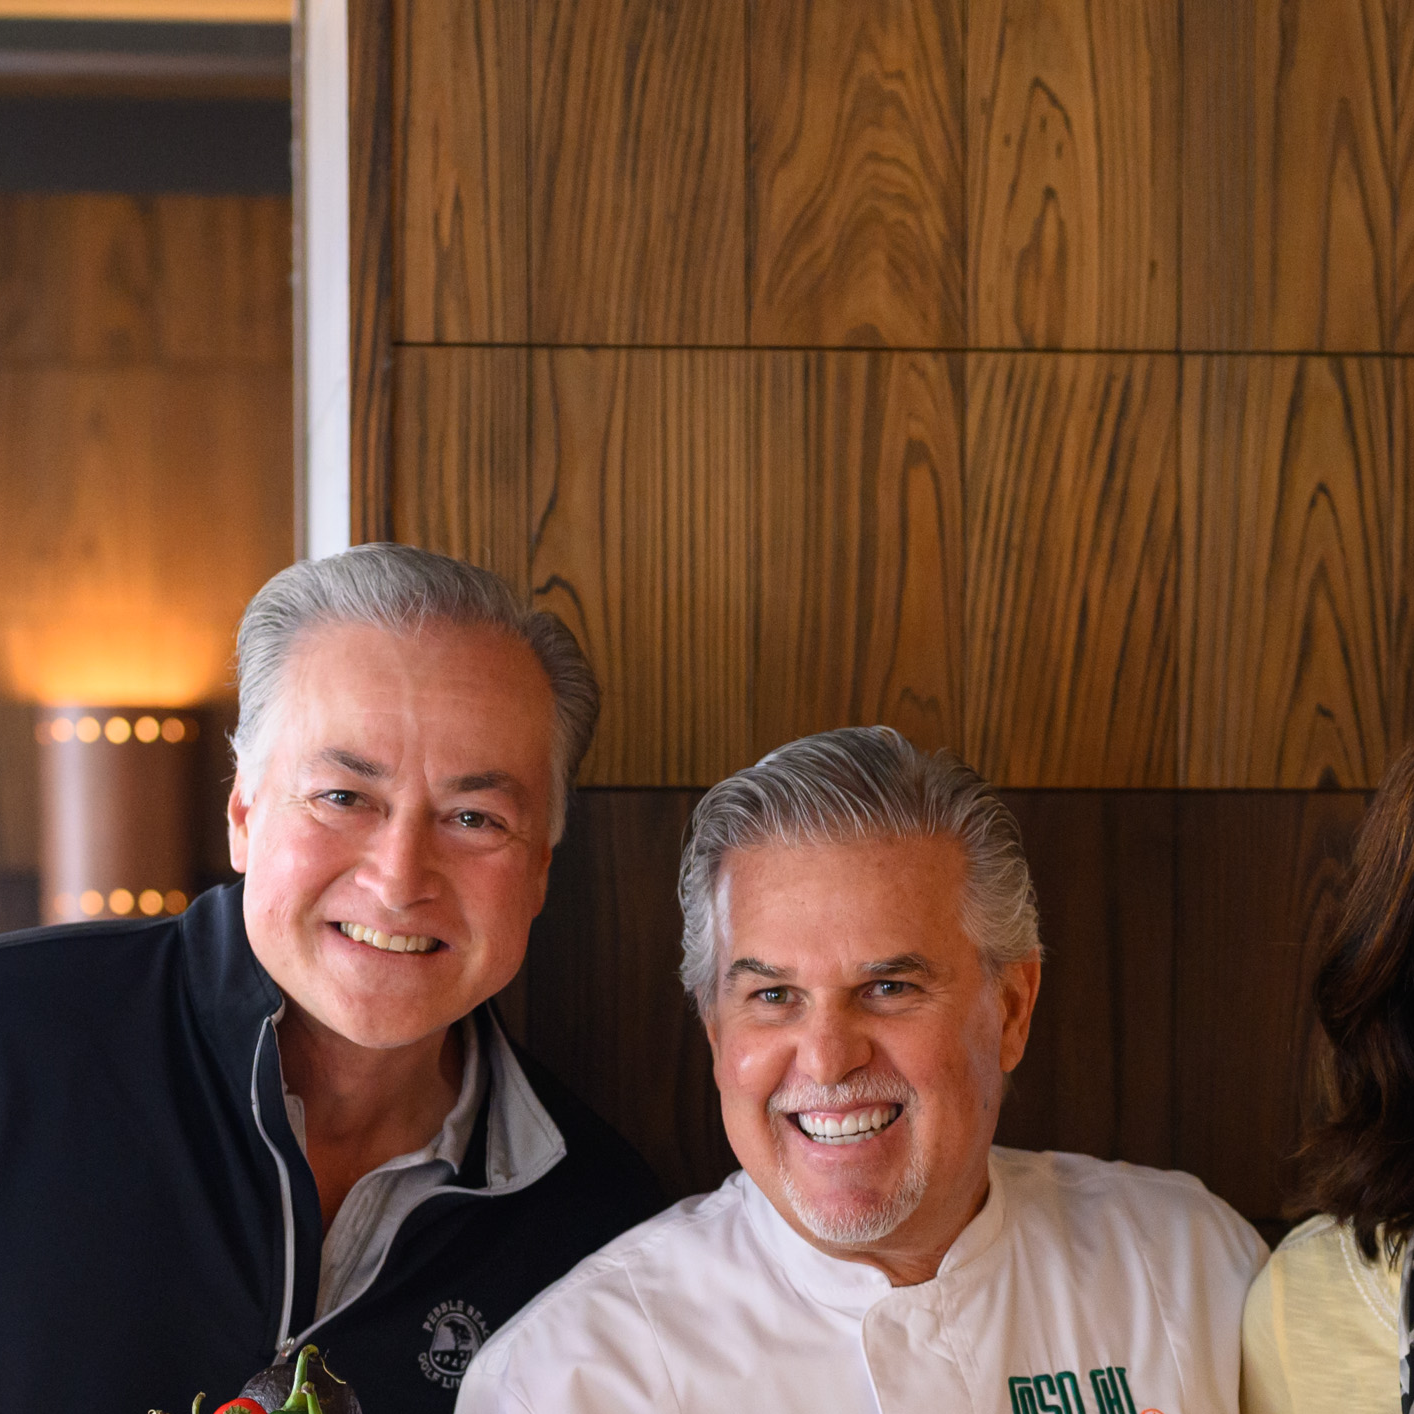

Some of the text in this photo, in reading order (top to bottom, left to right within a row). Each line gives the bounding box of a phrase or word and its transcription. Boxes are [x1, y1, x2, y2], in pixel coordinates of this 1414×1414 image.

[422, 1300, 491, 1339] PEBBLE BEAC
[418, 1352, 441, 1381] GOLF
